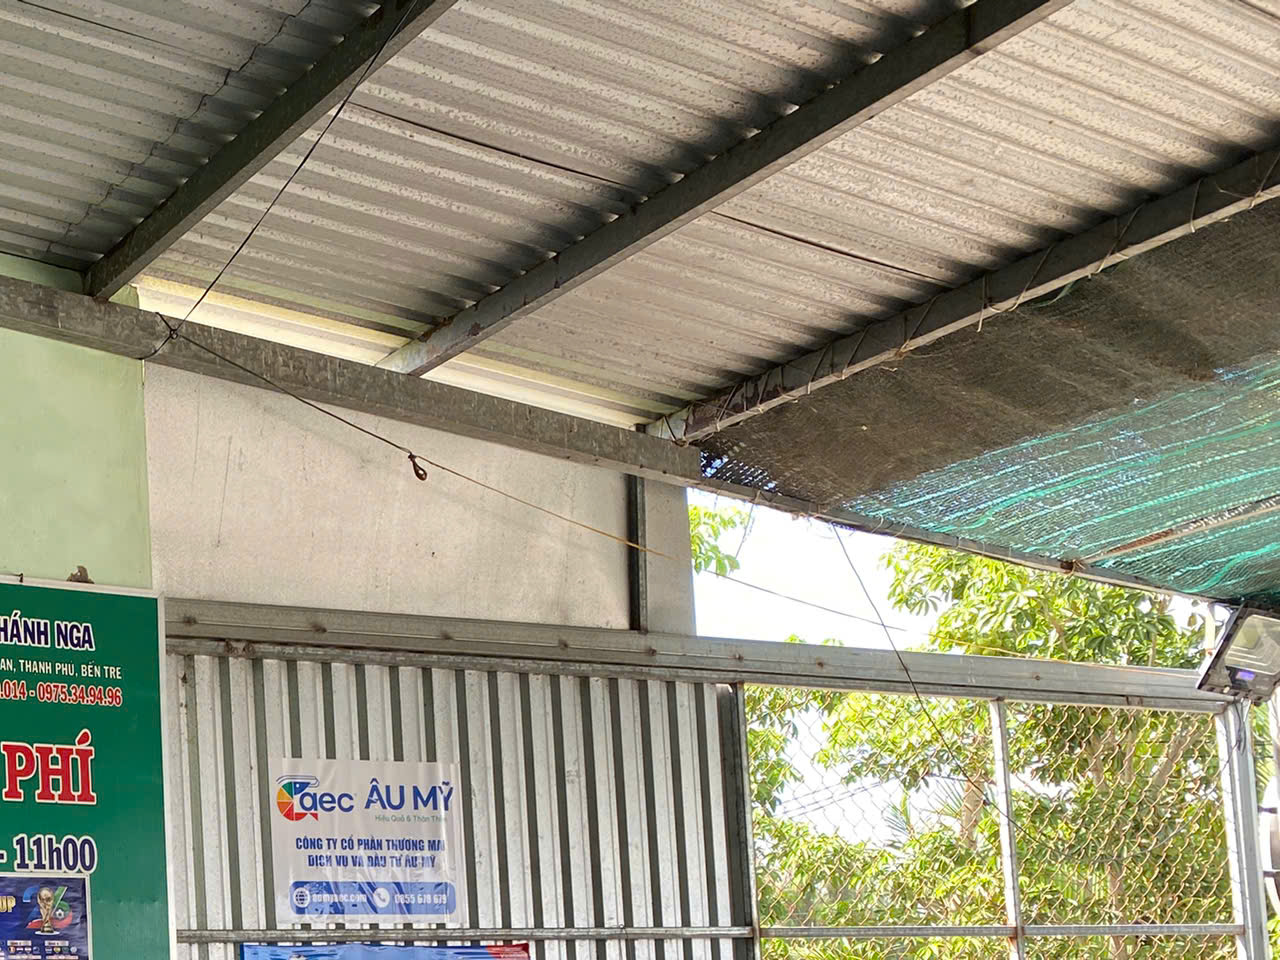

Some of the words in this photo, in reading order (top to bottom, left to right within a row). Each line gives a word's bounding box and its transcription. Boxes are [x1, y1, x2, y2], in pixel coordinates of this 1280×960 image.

[55, 621, 95, 650] NGA
[0, 659, 16, 673] AN,
[81, 660, 101, 678] BẾN
[104, 665, 122, 679] TRE
[37, 682, 122, 706] 0975.34.94.96
[2, 729, 97, 805] PHÍ
[299, 791, 354, 812] aec
[365, 777, 405, 810] ÂU
[412, 780, 453, 811] MỸ
[13, 834, 97, 874] 11h00
[296, 835, 323, 850] CÔNG
[326, 838, 338, 850] TY
[341, 834, 354, 851] CỔ
[357, 834, 383, 851] PHẦN
[385, 837, 425, 851] THƯƠNG
[308, 854, 332, 869] DỊCH
